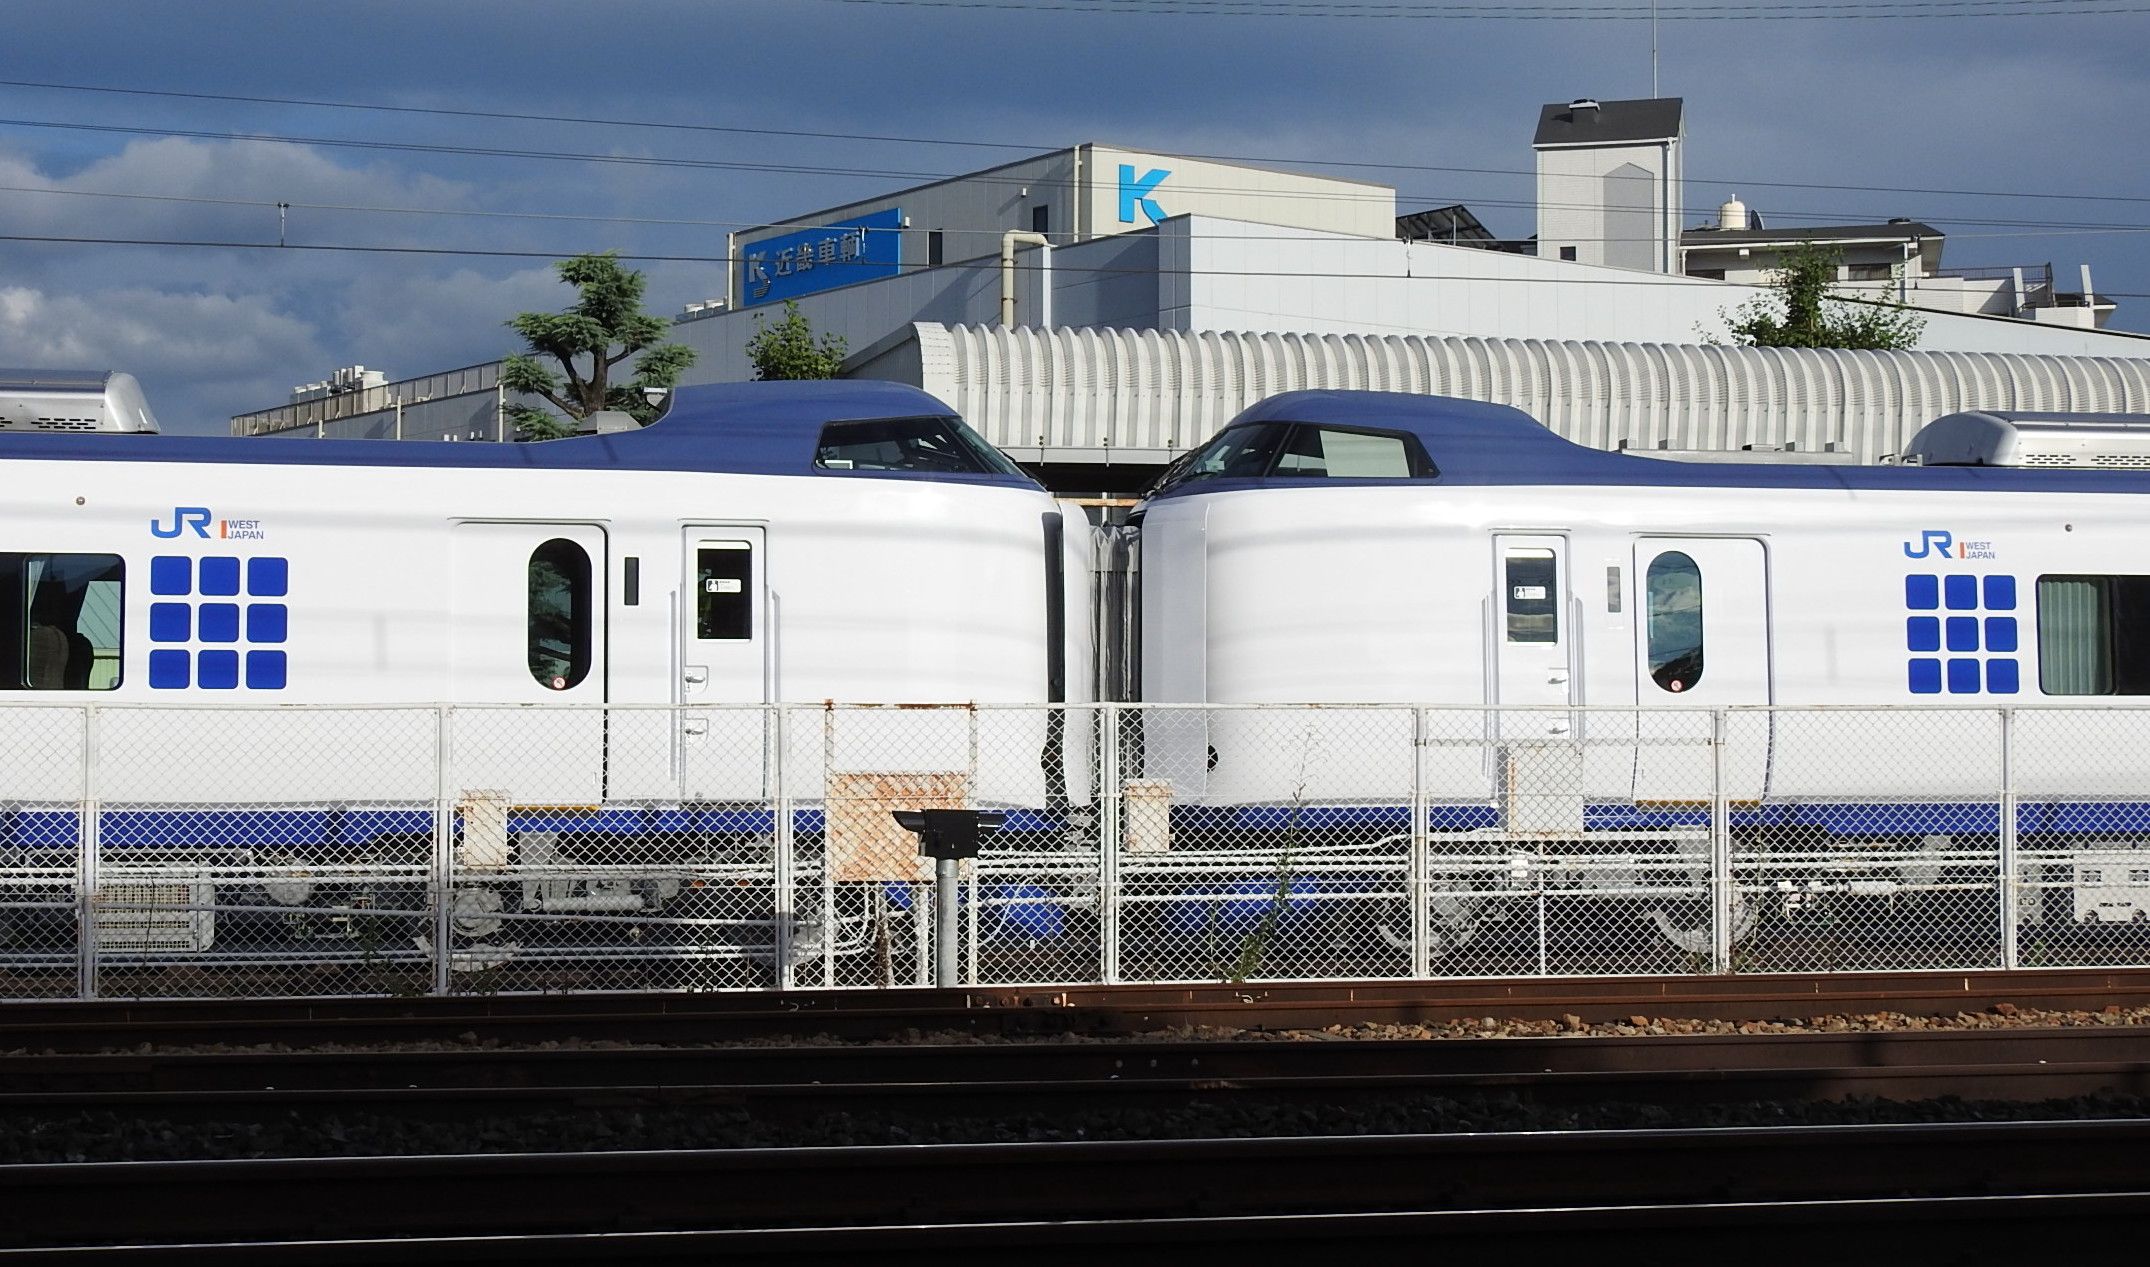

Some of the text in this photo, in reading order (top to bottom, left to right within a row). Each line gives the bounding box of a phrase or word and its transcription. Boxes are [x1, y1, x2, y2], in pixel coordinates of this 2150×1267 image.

[1118, 164, 1172, 226] K
[151, 507, 212, 538] JR
[228, 520, 260, 529] WEST
[228, 530, 264, 539] JAPAN
[1904, 530, 1953, 559] JR
[1966, 551, 1995, 559] JAPAN
